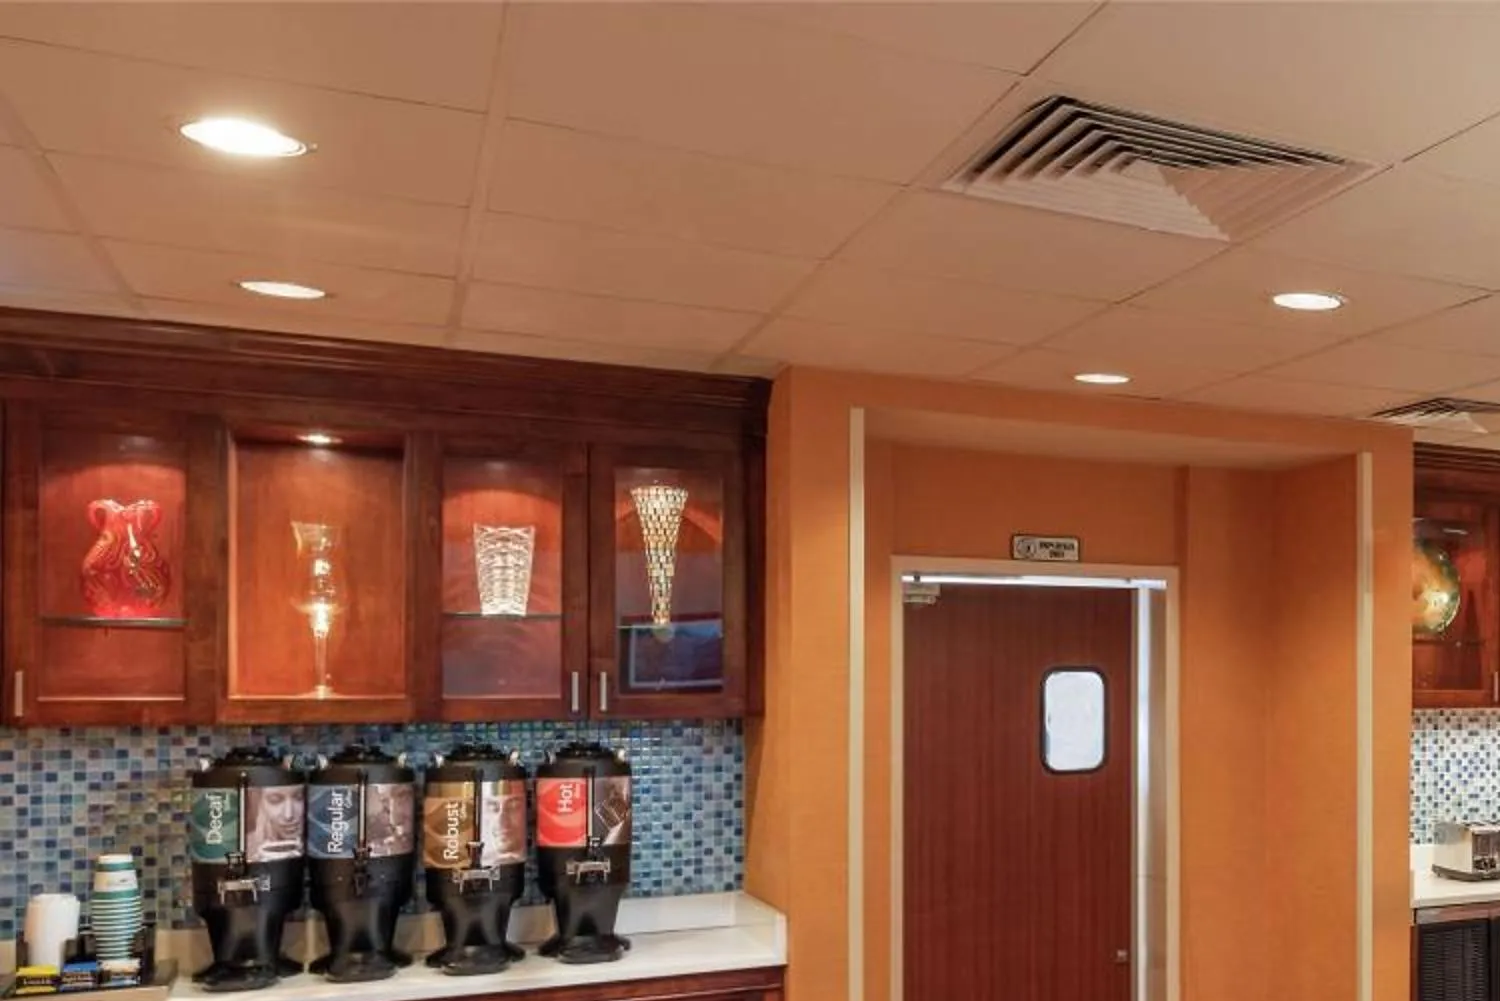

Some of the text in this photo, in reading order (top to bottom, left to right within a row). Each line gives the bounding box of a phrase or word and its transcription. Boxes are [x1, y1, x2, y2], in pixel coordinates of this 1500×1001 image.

[205, 791, 222, 845] Decaf
[327, 787, 350, 853] Regular
[557, 783, 573, 813] Hot
[443, 800, 460, 860] Robust
